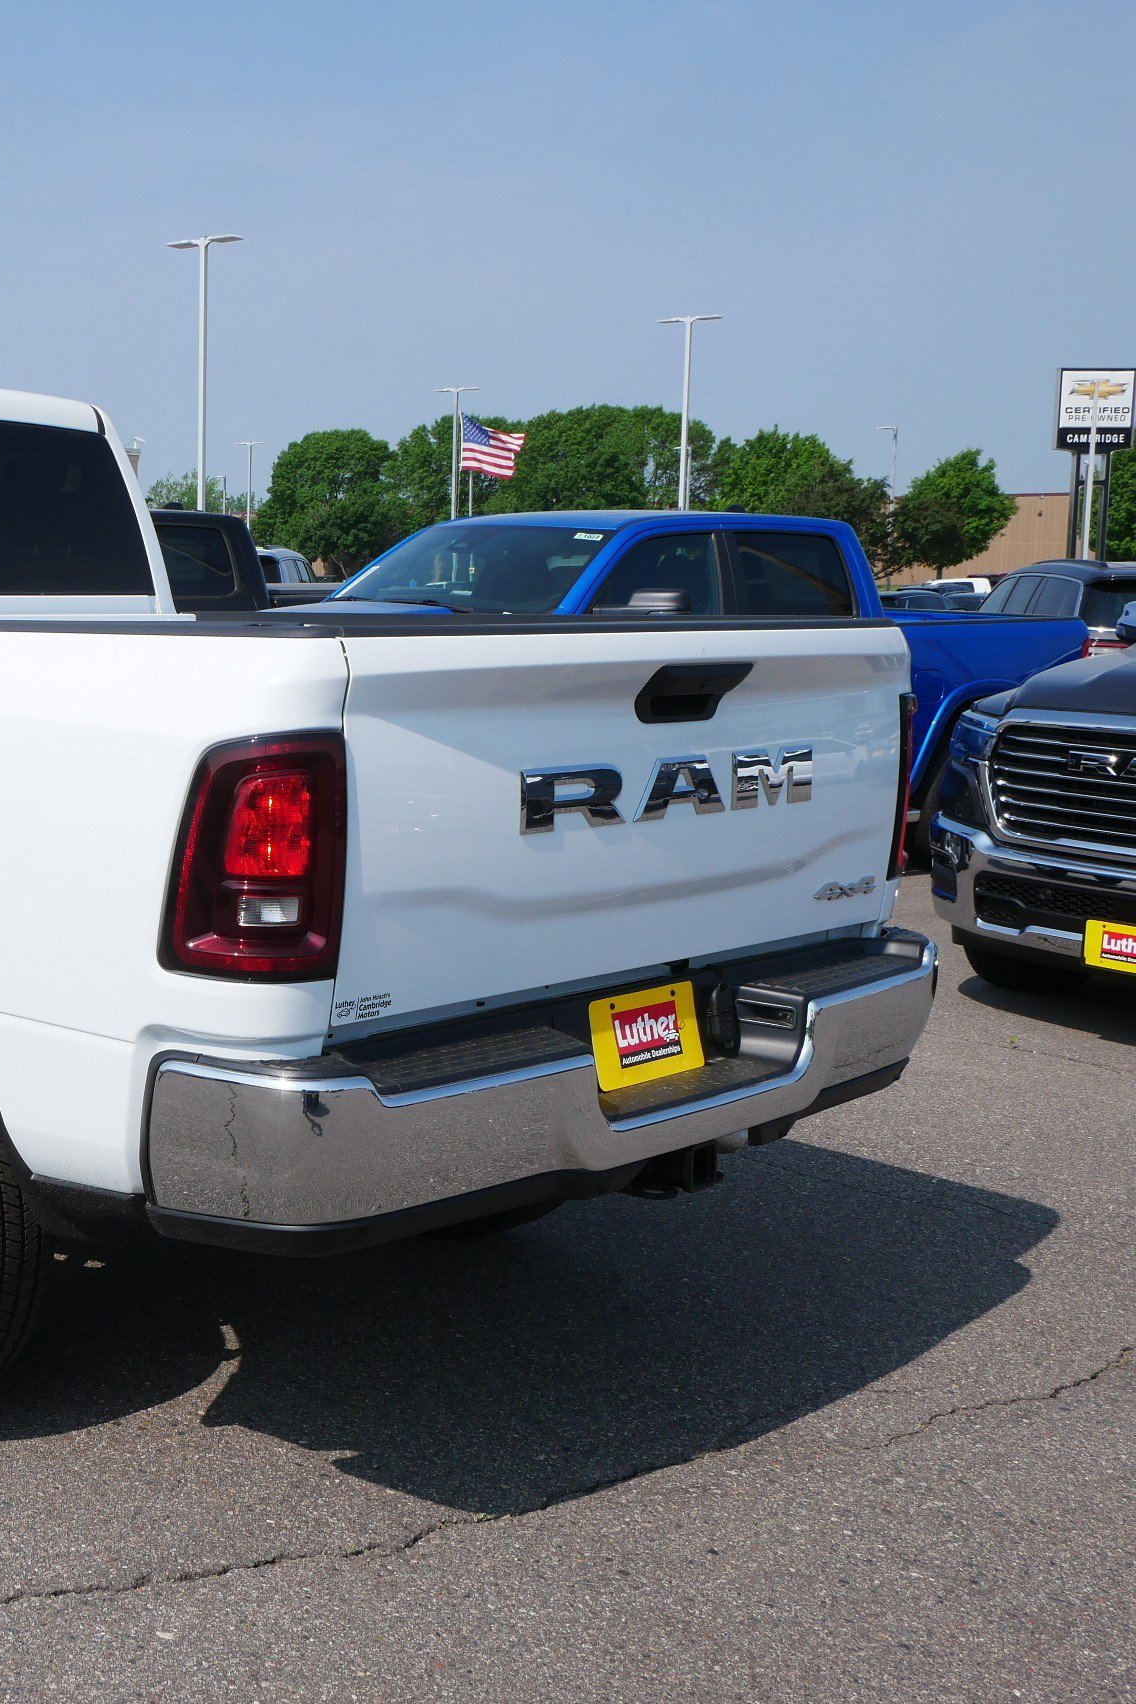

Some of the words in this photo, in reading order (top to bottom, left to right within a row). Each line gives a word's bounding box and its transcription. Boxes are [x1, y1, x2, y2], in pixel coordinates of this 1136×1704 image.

[1065, 406, 1130, 414] CERIFIED
[519, 744, 813, 836] RAM
[335, 1000, 355, 1009] Luther
[359, 999, 392, 1011] Cambridge
[357, 1009, 380, 1019] Motors
[614, 1013, 676, 1048] Luther
[622, 1052, 652, 1066] Automobile
[651, 1044, 681, 1059] Dealerships
